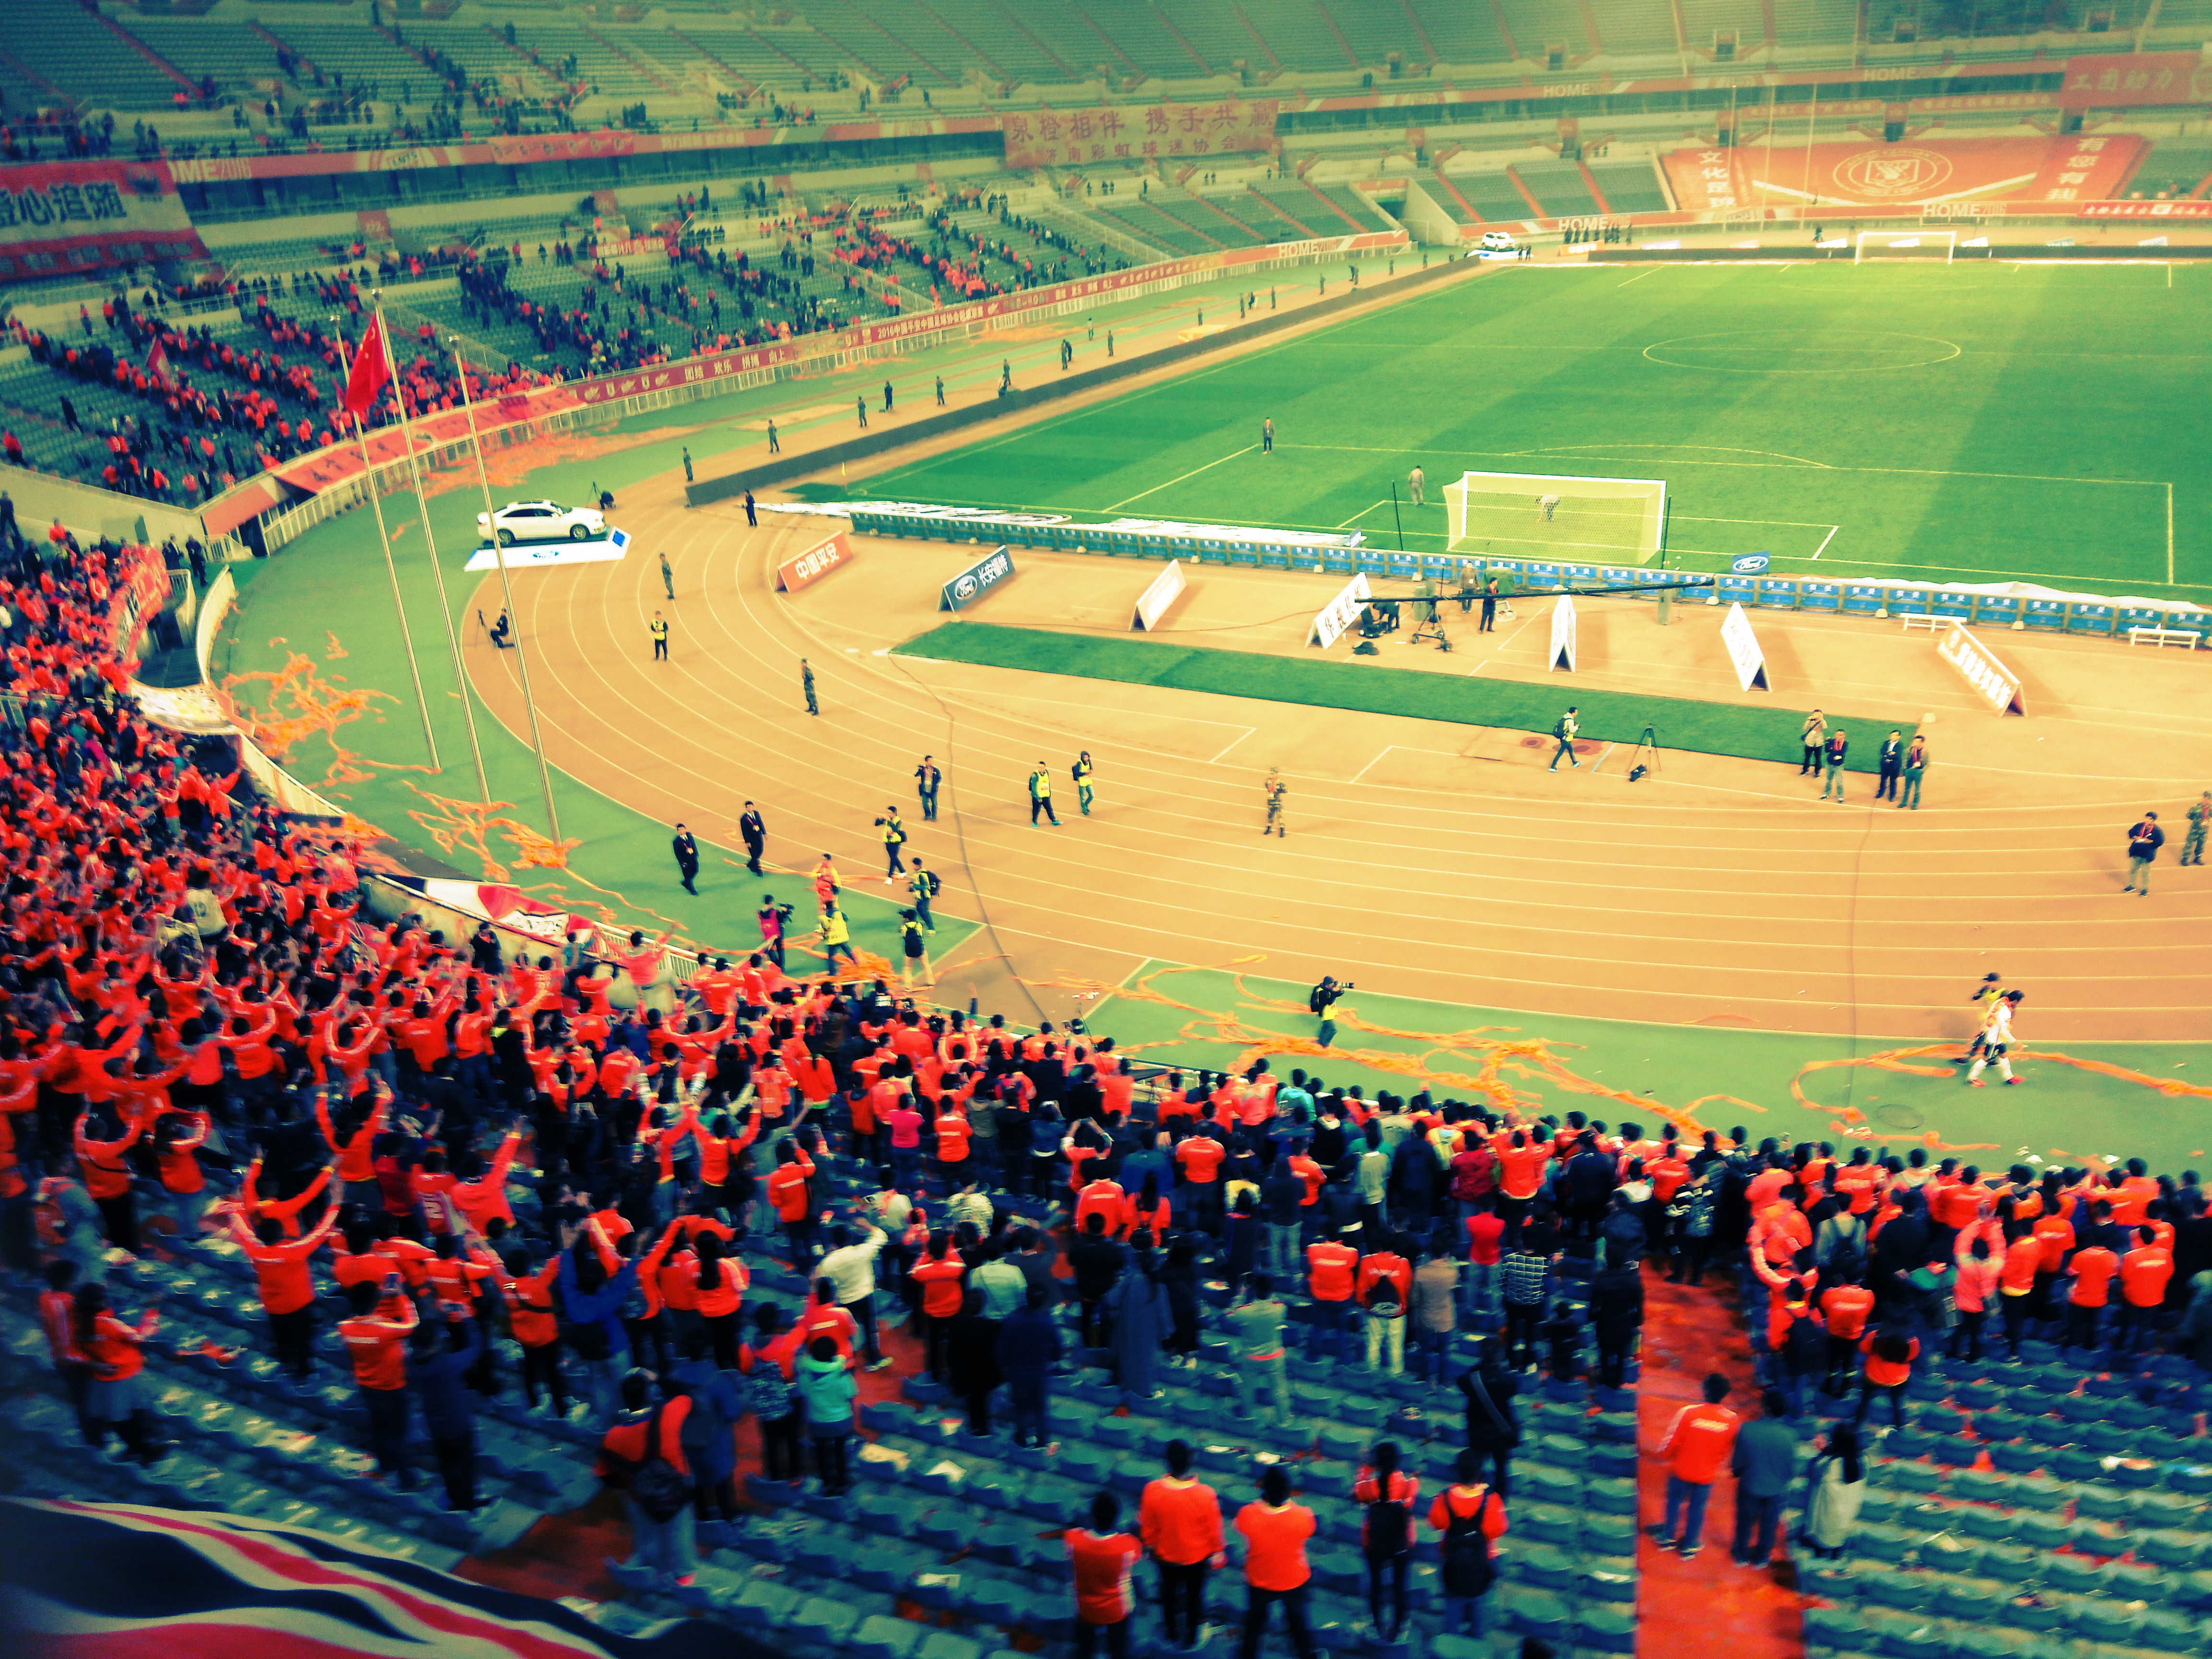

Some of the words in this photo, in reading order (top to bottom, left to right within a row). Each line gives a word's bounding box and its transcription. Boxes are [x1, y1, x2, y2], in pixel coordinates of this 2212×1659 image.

[1011, 110, 1125, 144] 泉橙相伴
[1145, 101, 1274, 136] 携手共赢
[794, 541, 840, 581] 中国平安
[978, 553, 1009, 587] 长安福特
[1739, 558, 1762, 570] Ford
